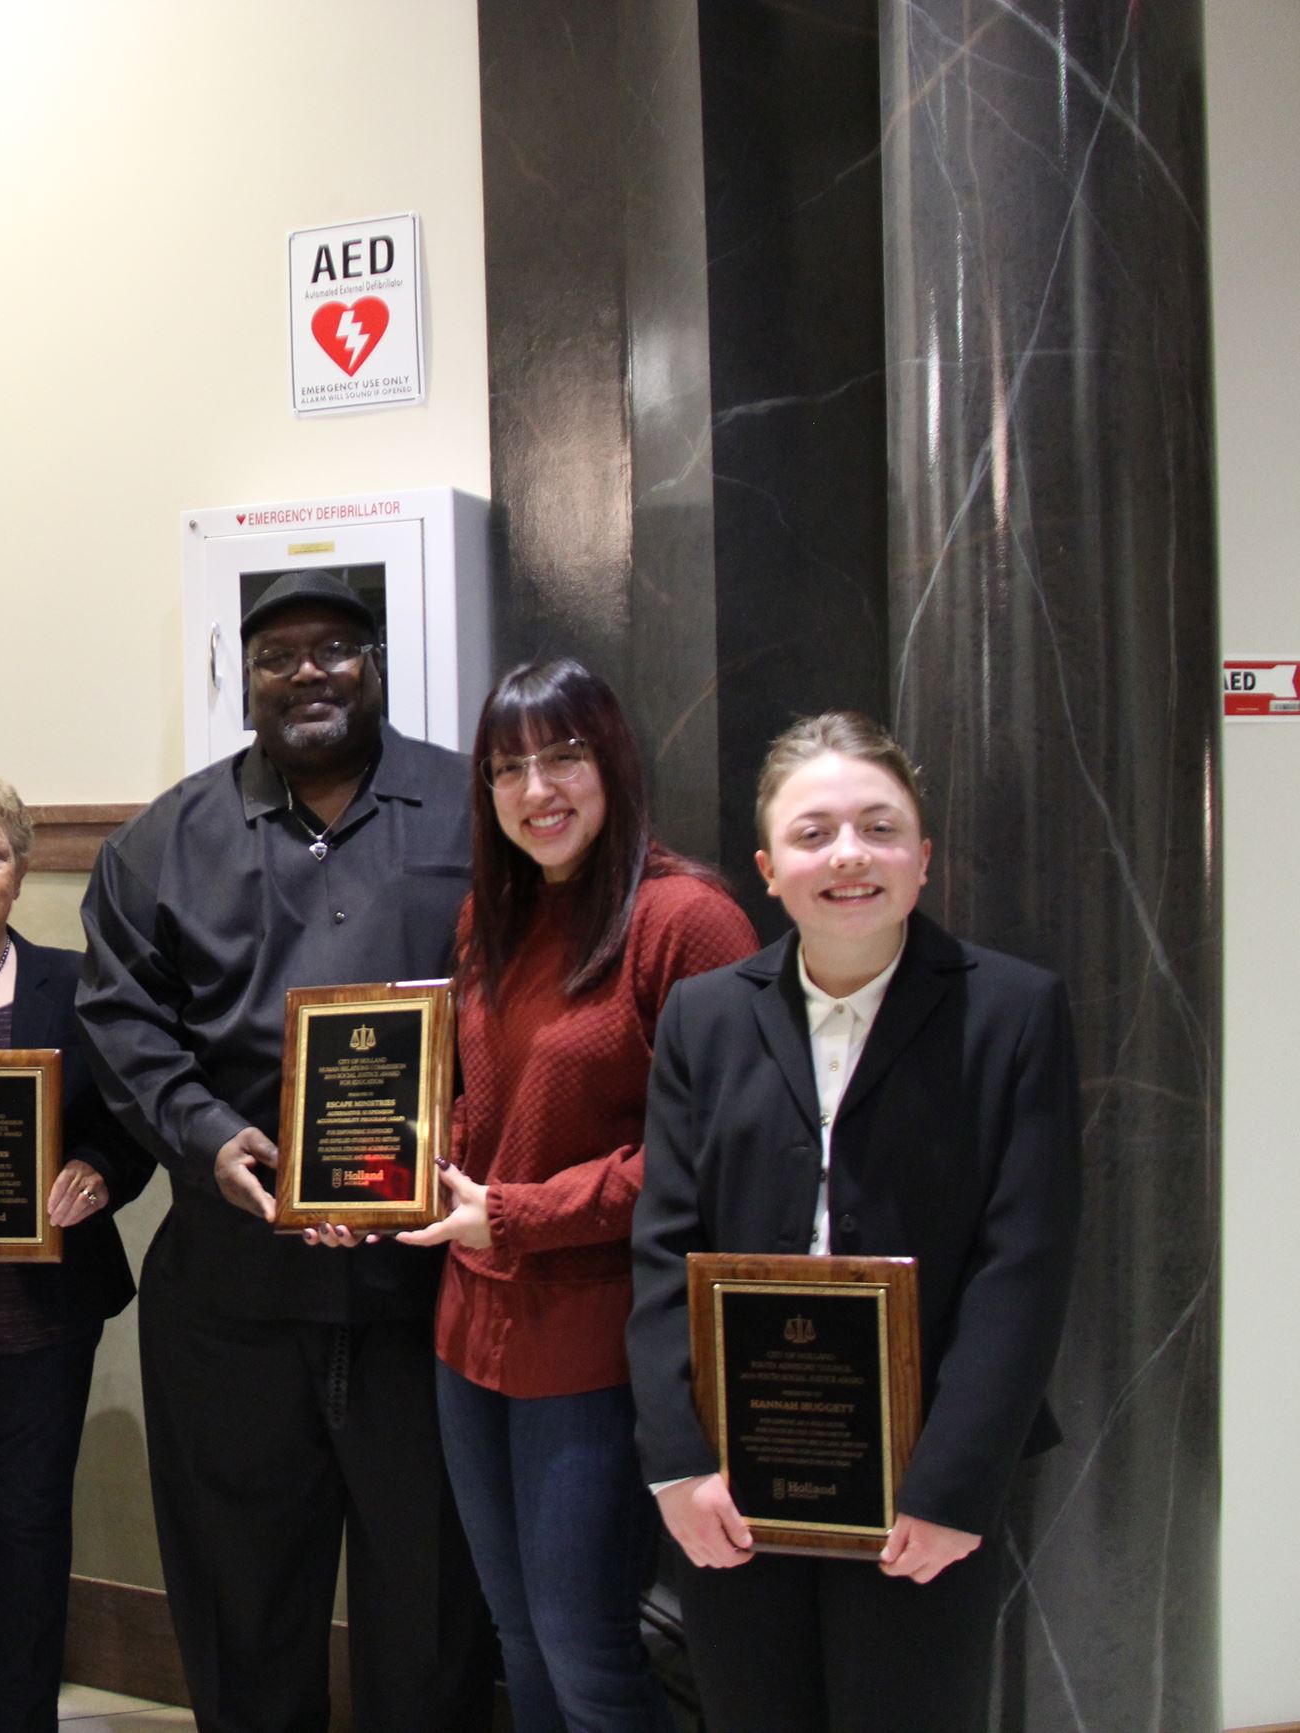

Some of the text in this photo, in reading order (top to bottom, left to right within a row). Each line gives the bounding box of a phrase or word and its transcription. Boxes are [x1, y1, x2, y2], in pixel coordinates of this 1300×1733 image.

[311, 235, 394, 283] AED
[301, 376, 409, 396] EMERGENCY USE ONLY
[301, 395, 326, 405] ALARM
[328, 393, 344, 401] WILL
[346, 390, 372, 399] SOUND
[382, 386, 412, 395] OPENED
[249, 501, 400, 526] EMERGENCY DEFIBRILLATOR
[343, 1170, 384, 1181] Holland
[750, 1399, 799, 1410] HANNAH
[788, 1481, 837, 1495] Holland
